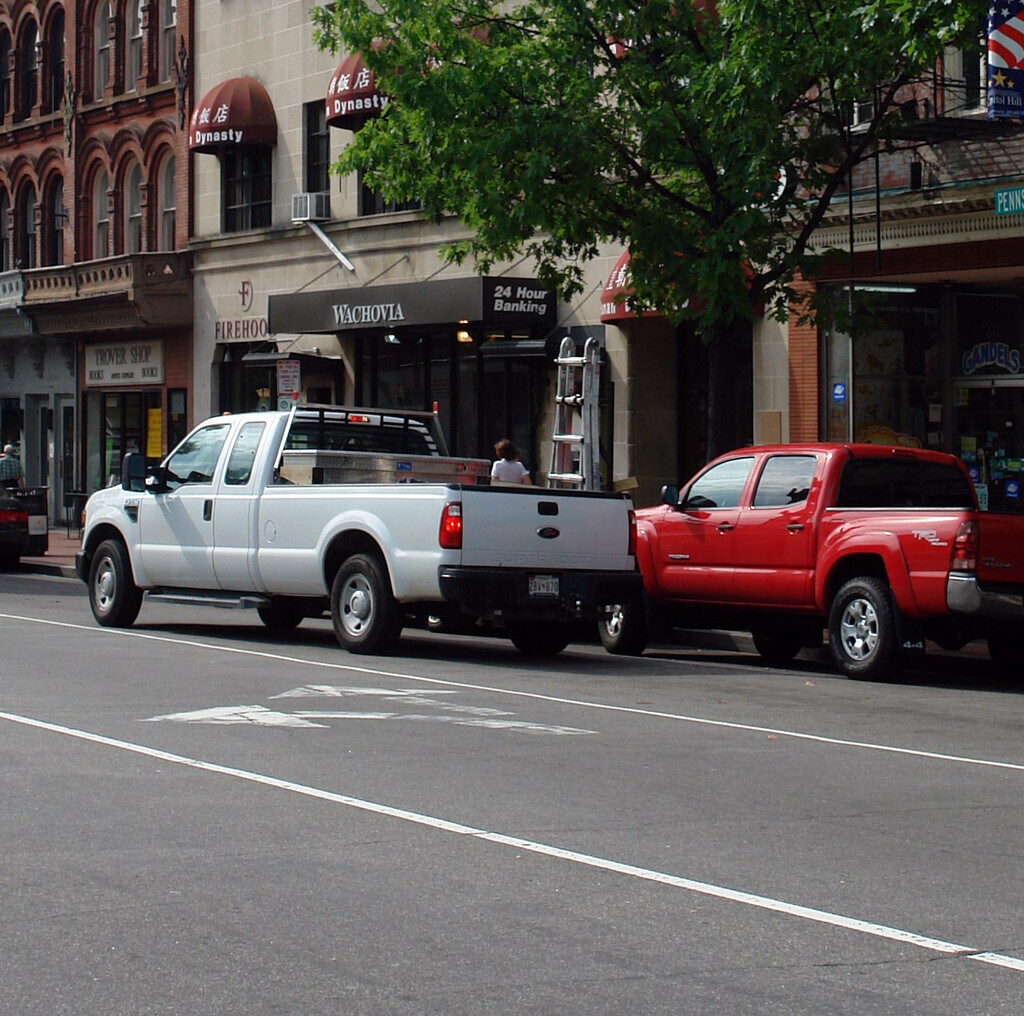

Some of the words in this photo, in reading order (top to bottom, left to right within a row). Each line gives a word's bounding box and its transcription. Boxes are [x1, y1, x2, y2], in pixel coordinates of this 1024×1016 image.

[334, 94, 389, 115] Dynasty
[1007, 96, 1022, 106] Hill
[195, 128, 243, 145] Dynasty
[493, 285, 512, 298] 24
[516, 286, 548, 300] Hour
[332, 302, 405, 325] WACHOVIA
[494, 299, 547, 315] Banking
[215, 318, 268, 340] FIREHOO
[94, 347, 127, 366] TROVER
[130, 345, 152, 364] SHOP
[961, 341, 1020, 375] GANDELS
[88, 369, 104, 381] BOOKS
[141, 366, 159, 378] BOOKS
